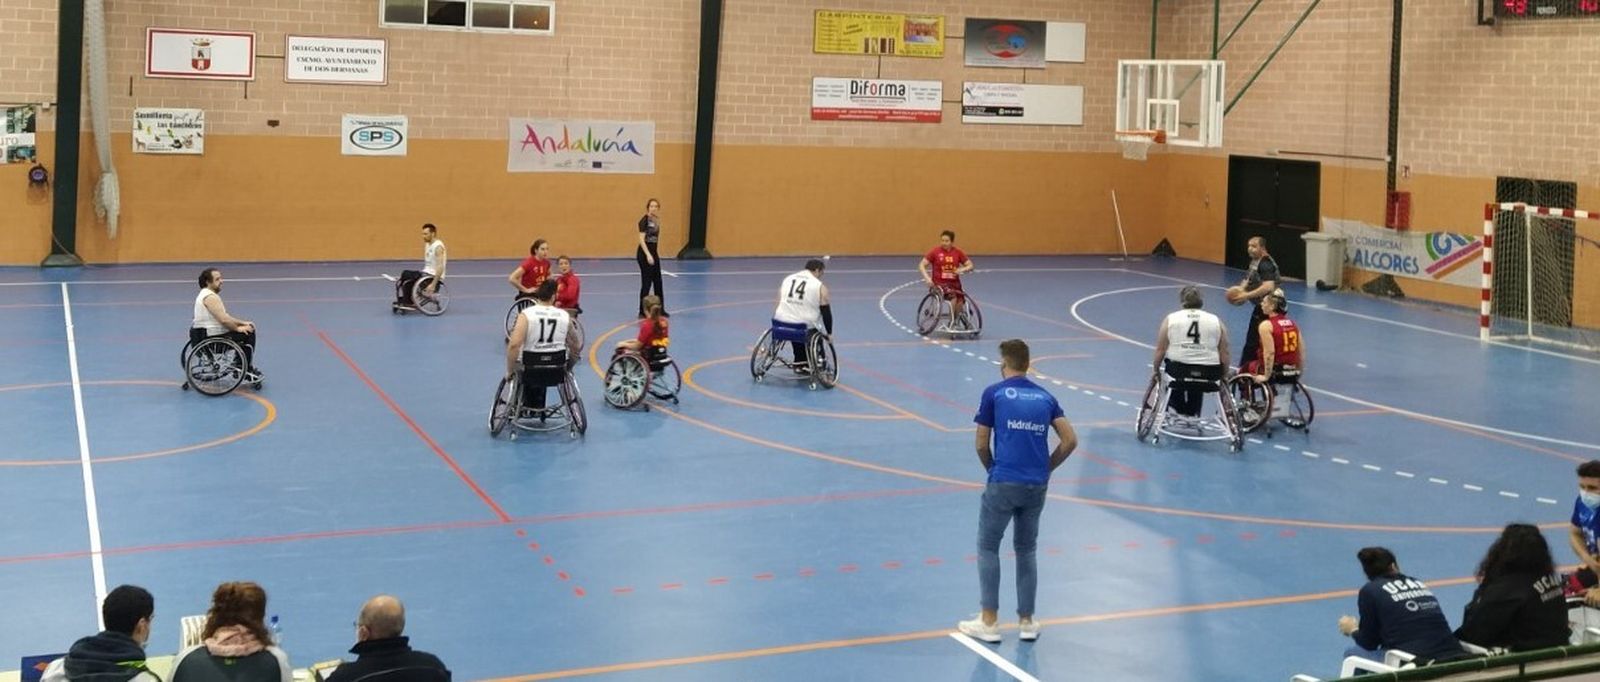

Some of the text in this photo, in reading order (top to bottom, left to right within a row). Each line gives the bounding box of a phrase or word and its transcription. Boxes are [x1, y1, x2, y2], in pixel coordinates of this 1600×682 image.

[850, 80, 906, 96] Diforma
[359, 131, 394, 142] SPS
[520, 123, 643, 157] Andalucía
[1353, 248, 1420, 275] ALCORES
[787, 279, 807, 300] 14
[538, 318, 557, 343] 17
[1186, 321, 1201, 345] 4
[1283, 331, 1298, 352] 13
